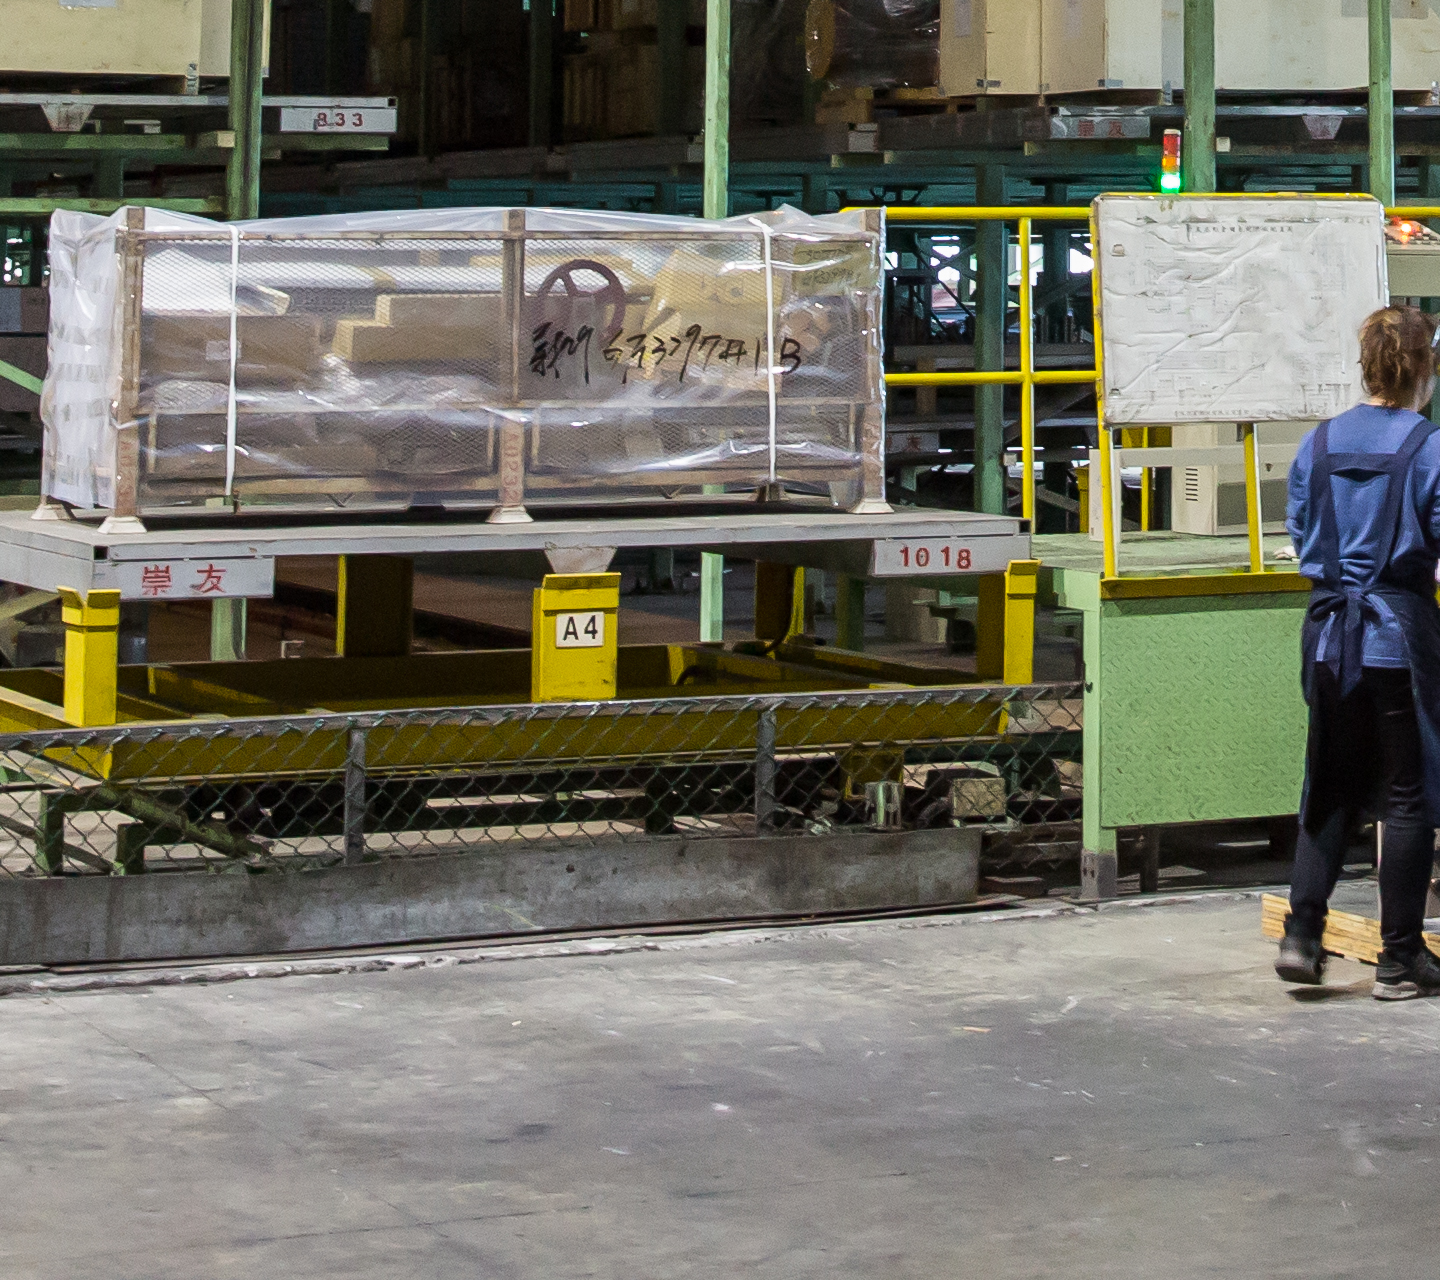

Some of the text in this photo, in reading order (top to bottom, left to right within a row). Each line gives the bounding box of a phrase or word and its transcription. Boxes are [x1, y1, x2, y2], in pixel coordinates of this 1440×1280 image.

[898, 545, 972, 570] 1018
[141, 563, 228, 596] 崇友
[562, 615, 599, 642] A4
